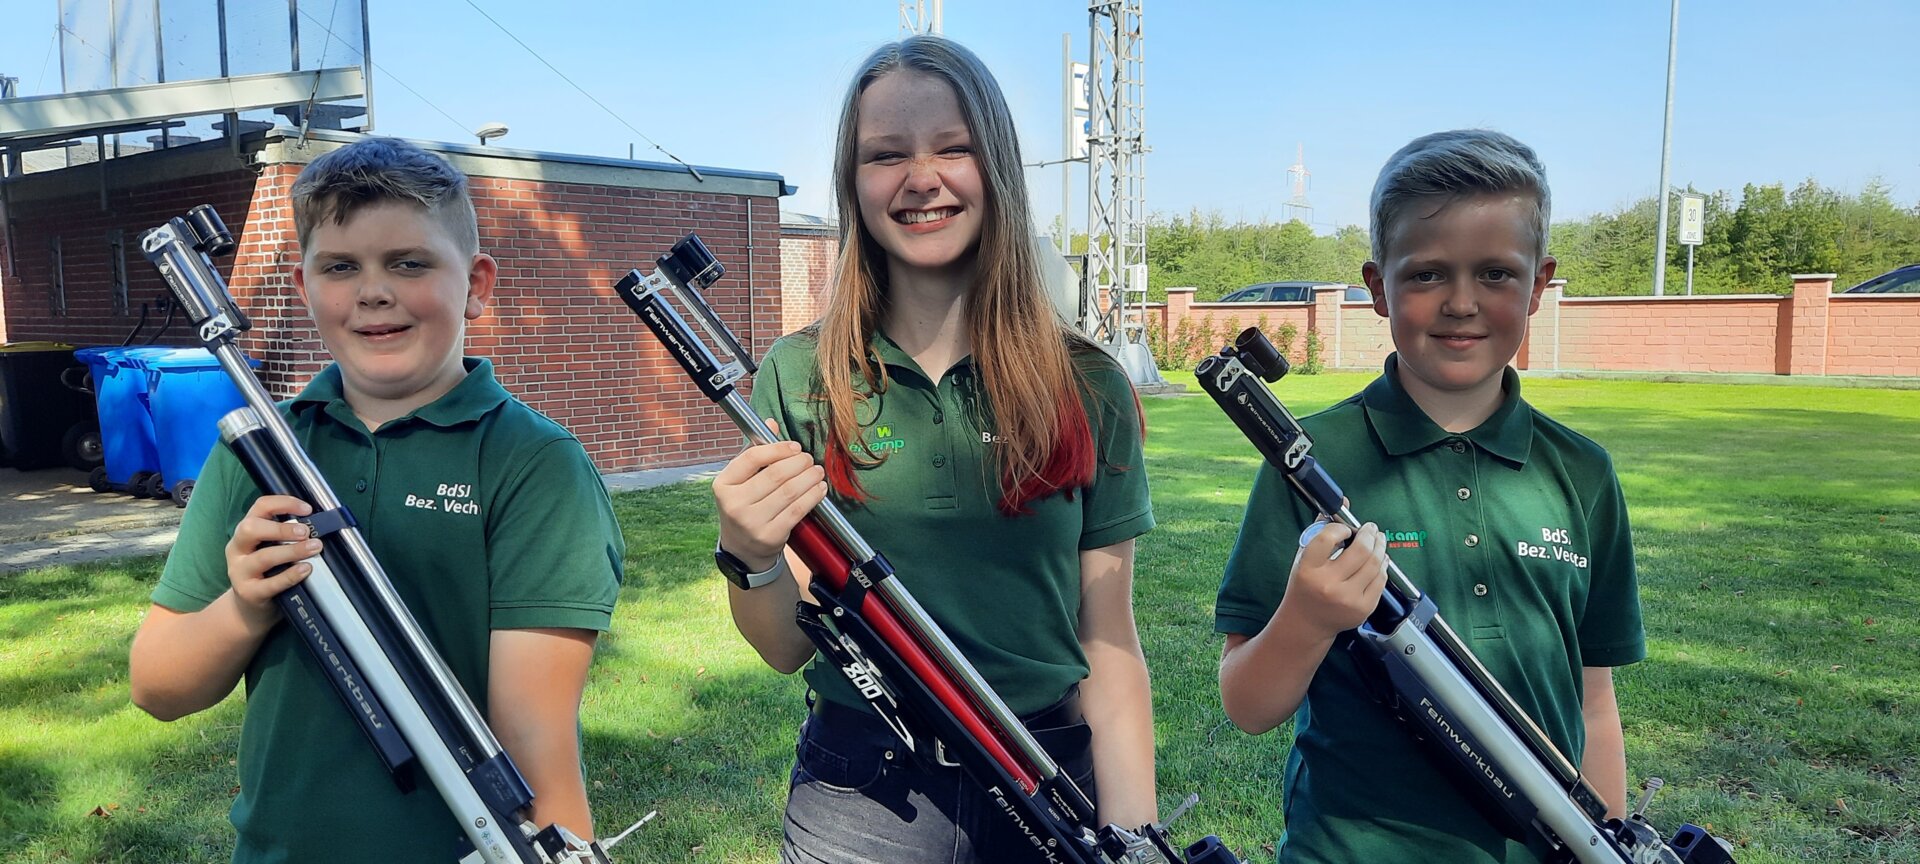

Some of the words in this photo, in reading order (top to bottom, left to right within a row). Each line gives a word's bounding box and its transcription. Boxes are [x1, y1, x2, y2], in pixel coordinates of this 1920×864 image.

[1688, 208, 1697, 222] 30
[644, 306, 702, 373] Feinwerkbau
[1247, 402, 1284, 444] Feinwerkbau
[436, 483, 472, 498] BdSJ
[405, 494, 437, 511] Bez.
[443, 498, 483, 515] Vech
[1517, 541, 1551, 559] Bez.
[1552, 545, 1588, 569] Vecta
[850, 567, 874, 589] 800
[1410, 613, 1424, 631] 700
[290, 594, 384, 730] Feinwerkbau
[842, 662, 883, 700] 800
[1419, 697, 1514, 799] Feinwerkbau
[988, 785, 1064, 864] Feinwerk
